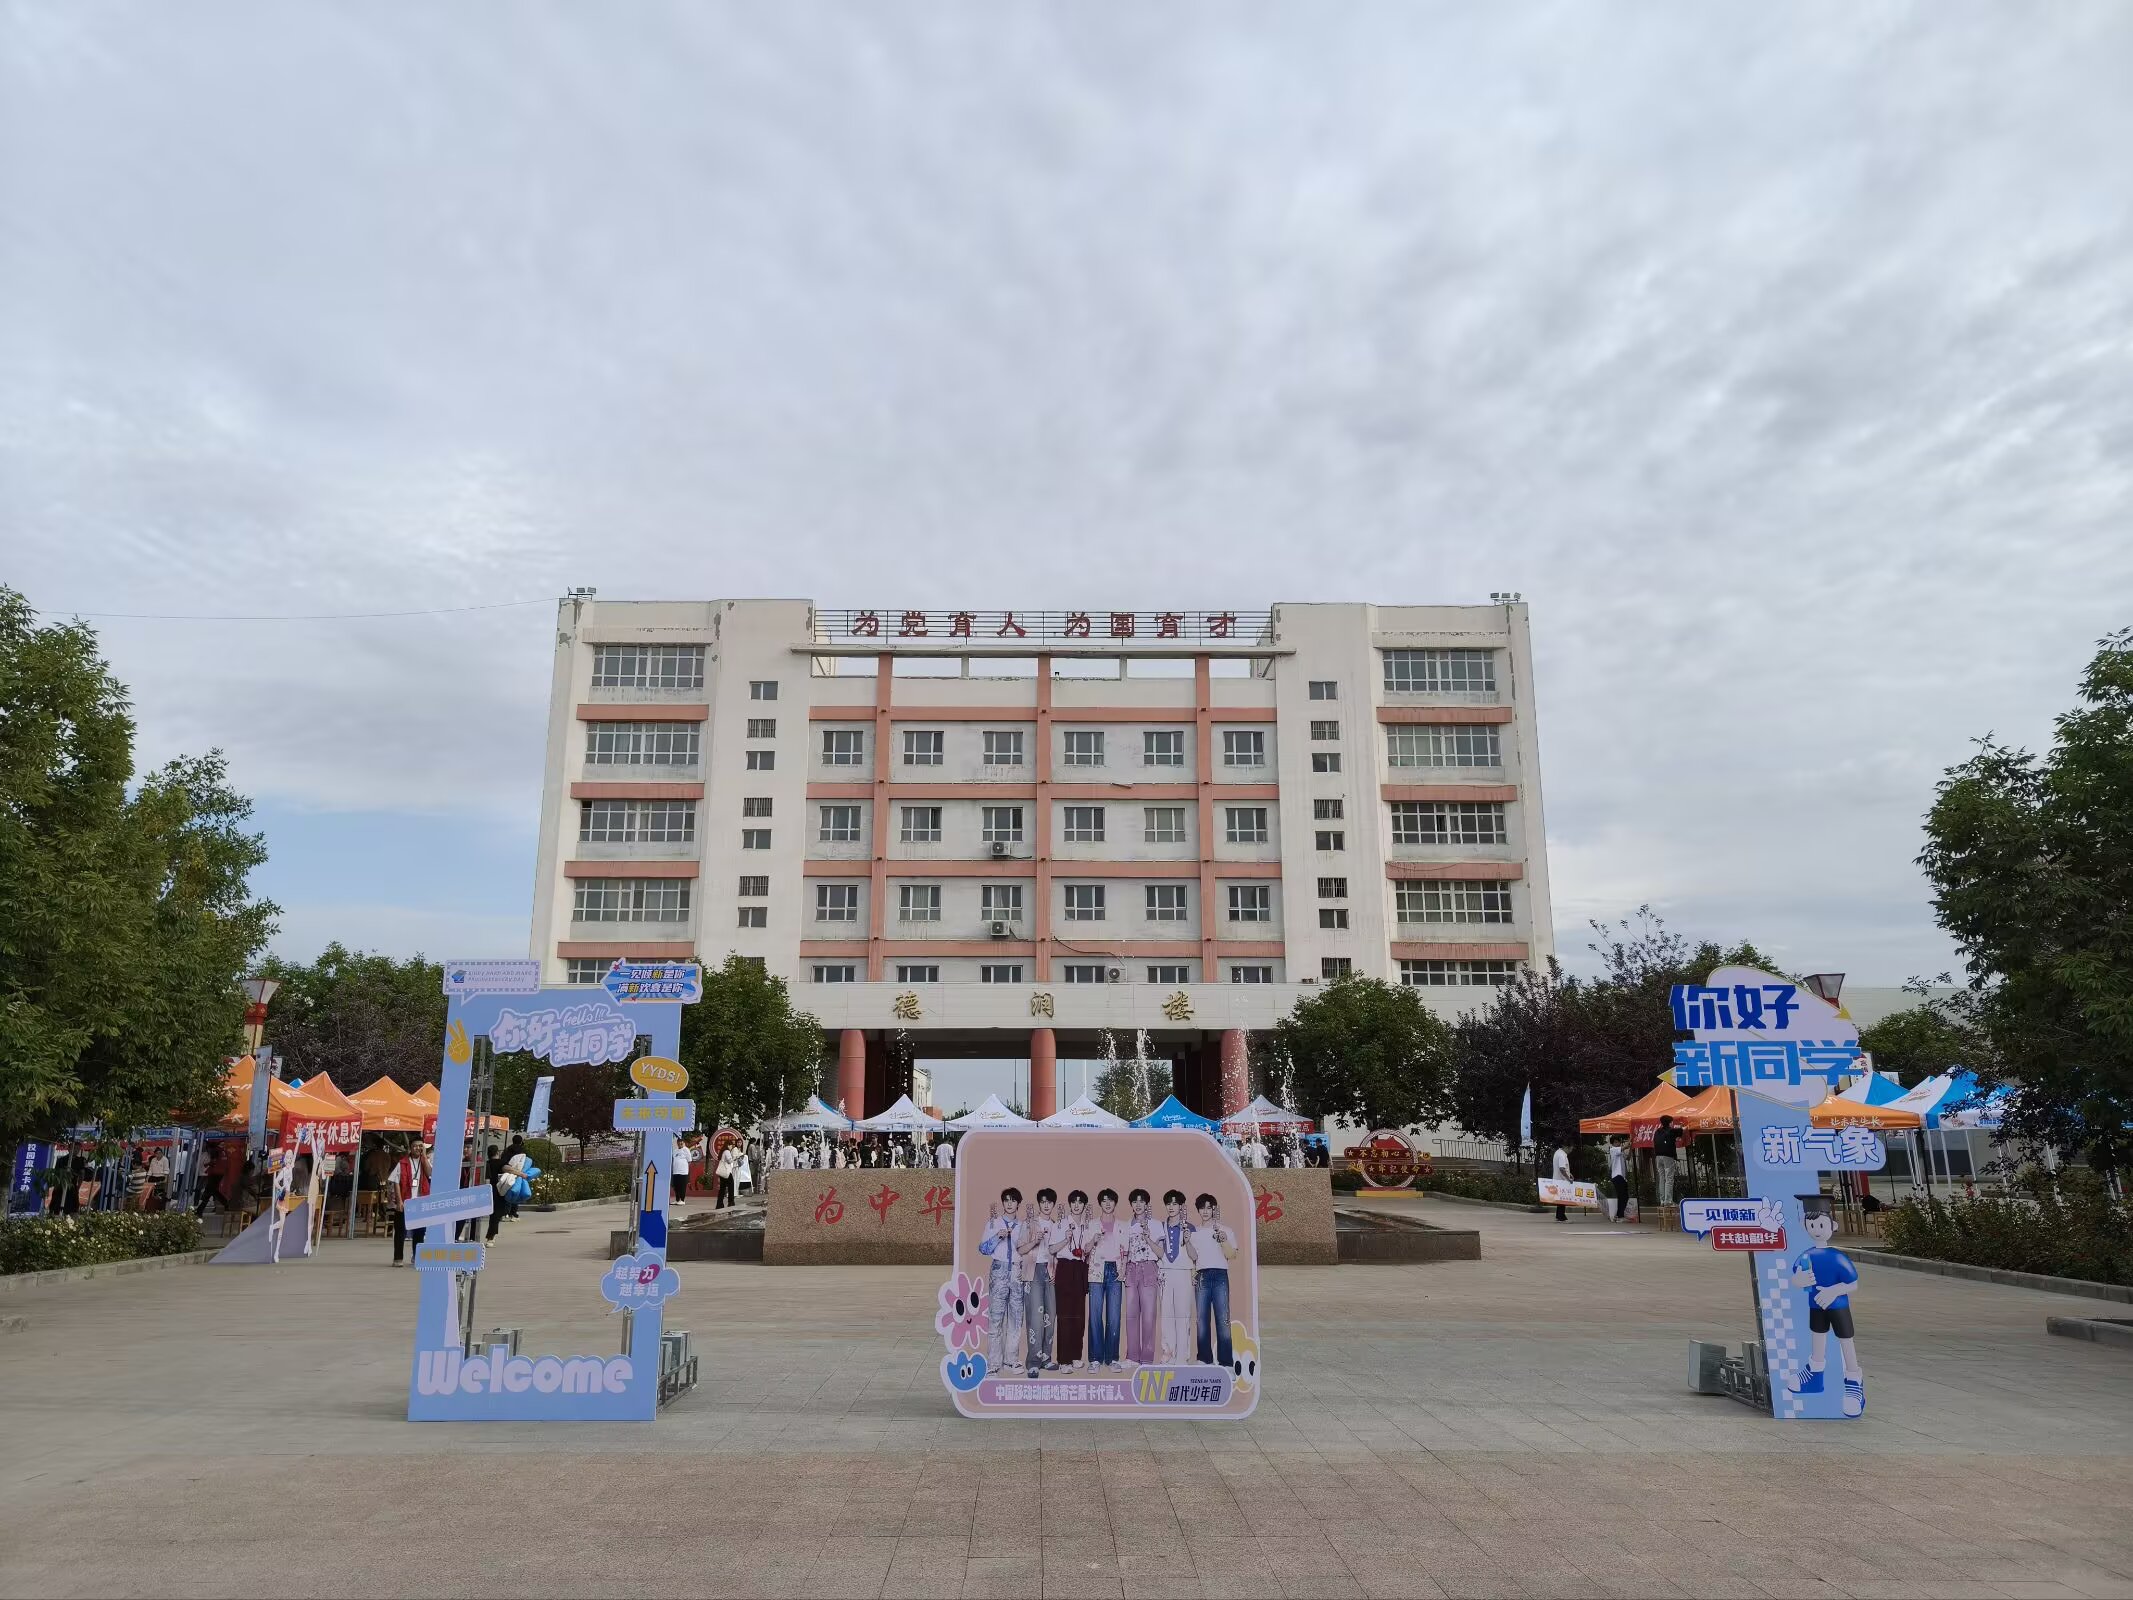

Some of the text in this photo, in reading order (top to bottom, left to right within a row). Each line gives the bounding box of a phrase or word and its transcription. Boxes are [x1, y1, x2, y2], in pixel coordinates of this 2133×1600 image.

[851, 610, 1237, 638] 为党育人 为国育才
[1669, 984, 1799, 1030] 你好
[493, 1012, 561, 1050] 你好
[554, 1023, 632, 1062] 新同学
[641, 1062, 681, 1084] YYDS!
[1672, 1040, 1863, 1086] 新同学
[1360, 1149, 1400, 1158] 不忘初心
[1762, 1126, 1880, 1165] 新气象
[1379, 1165, 1421, 1174] 牢记使命
[1689, 1208, 1756, 1222] 一见倾新
[1720, 1232, 1779, 1245] 共赴韶华
[615, 1266, 655, 1280] 越努力
[418, 1350, 634, 1396] Welcome
[1168, 1385, 1222, 1402] 时代少年团
